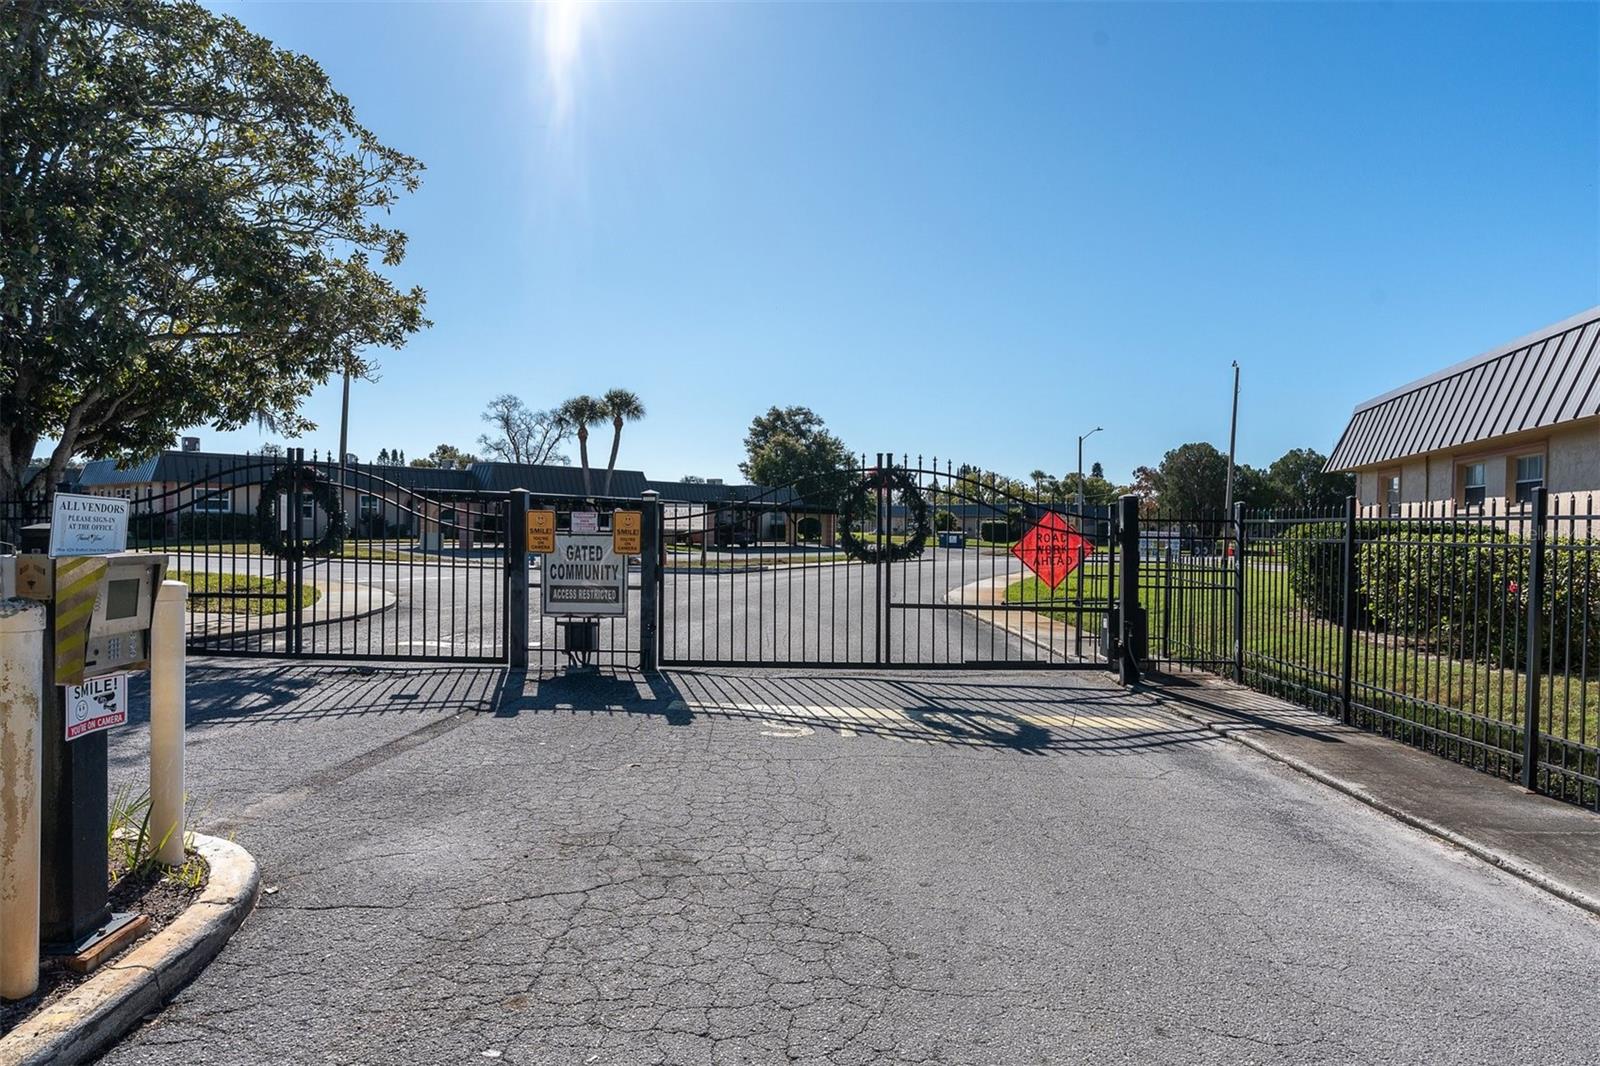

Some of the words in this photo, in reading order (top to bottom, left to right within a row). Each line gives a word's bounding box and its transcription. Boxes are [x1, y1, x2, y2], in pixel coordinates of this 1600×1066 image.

[60, 501, 80, 511] ALL
[82, 502, 125, 514] VENDORS
[68, 514, 91, 522] PLEASE
[529, 527, 553, 535] SMILE!
[616, 528, 640, 536] SMILE!
[1036, 533, 1068, 543] ROAD
[566, 545, 603, 561] GATED
[1033, 555, 1073, 566] AHEAD
[550, 563, 619, 580] COMMUNITY
[553, 588, 577, 600] ACCESS
[578, 588, 617, 600] RESTRICTED
[74, 677, 118, 700] SMILE!
[87, 720, 96, 730] ON
[97, 714, 123, 727] CAMERA
